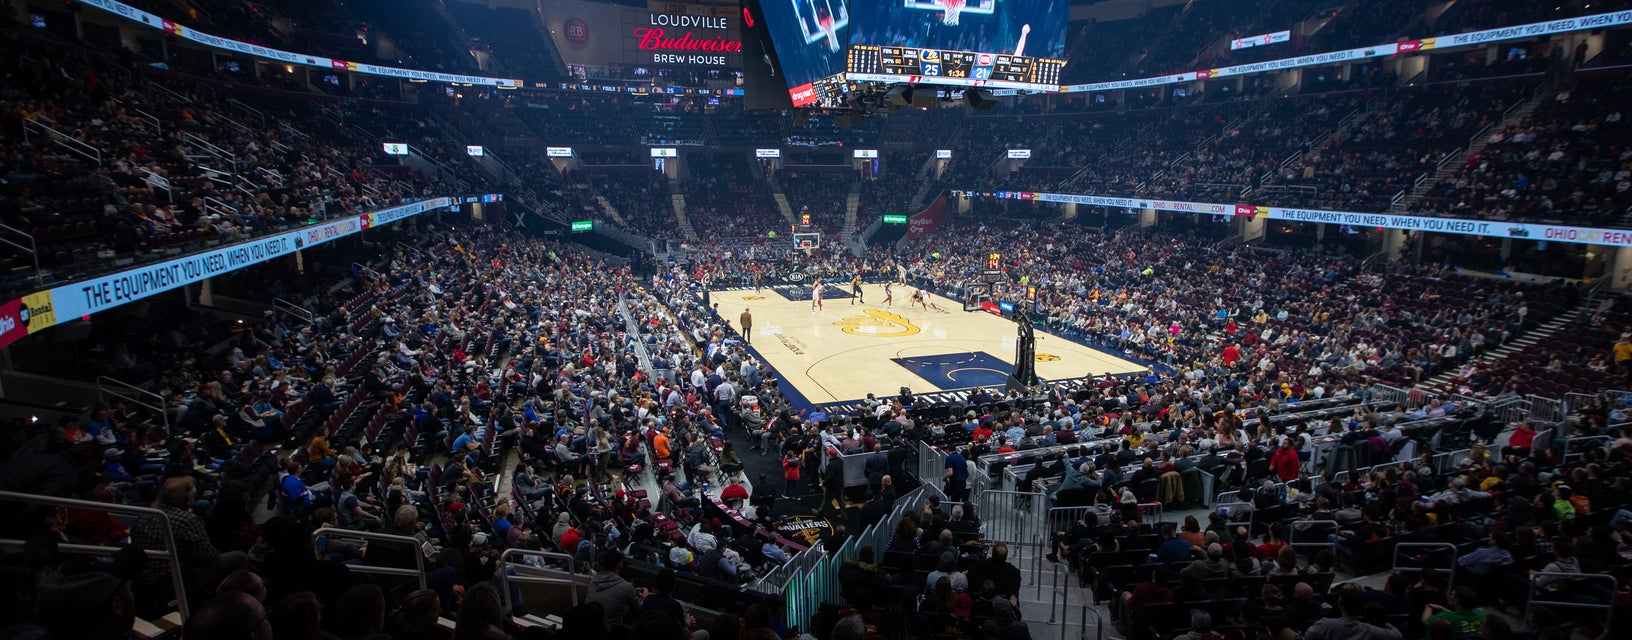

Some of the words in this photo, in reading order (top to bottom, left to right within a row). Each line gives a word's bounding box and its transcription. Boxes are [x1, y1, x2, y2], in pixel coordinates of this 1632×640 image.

[651, 14, 726, 28] LOUDVILLE
[1453, 35, 1468, 44] THE
[1470, 27, 1522, 42] EQUIPMENT
[1525, 24, 1544, 34] YOU
[1579, 14, 1612, 27] WHEN
[634, 27, 742, 52] Budweiser
[654, 54, 684, 63] BREW
[688, 55, 726, 65] HOUSE
[1238, 64, 1267, 73] EQUIPMENT
[1329, 52, 1345, 60] NEED
[378, 67, 409, 77] EQUIPMENT
[925, 65, 938, 75] 25
[976, 68, 986, 78] 21
[1282, 210, 1295, 218] THE
[1296, 211, 1341, 222] EQUIPMENT
[1344, 214, 1360, 223] YOU
[1363, 216, 1388, 226] NEED,
[1392, 218, 1420, 228] WHEN
[1423, 220, 1443, 229] YOU
[1446, 221, 1475, 232] NEED
[1478, 223, 1490, 234] IT.
[990, 260, 998, 269] 14
[82, 284, 111, 309] THE
[114, 264, 180, 301] EQUIPMENT
[180, 261, 201, 280] YOU
[202, 255, 227, 273] NEED,
[227, 250, 250, 266] WHEN
[250, 245, 265, 259] YOU
[265, 241, 281, 256] NEED
[30, 302, 52, 317] Rental
[784, 520, 829, 531] AVALIERS
